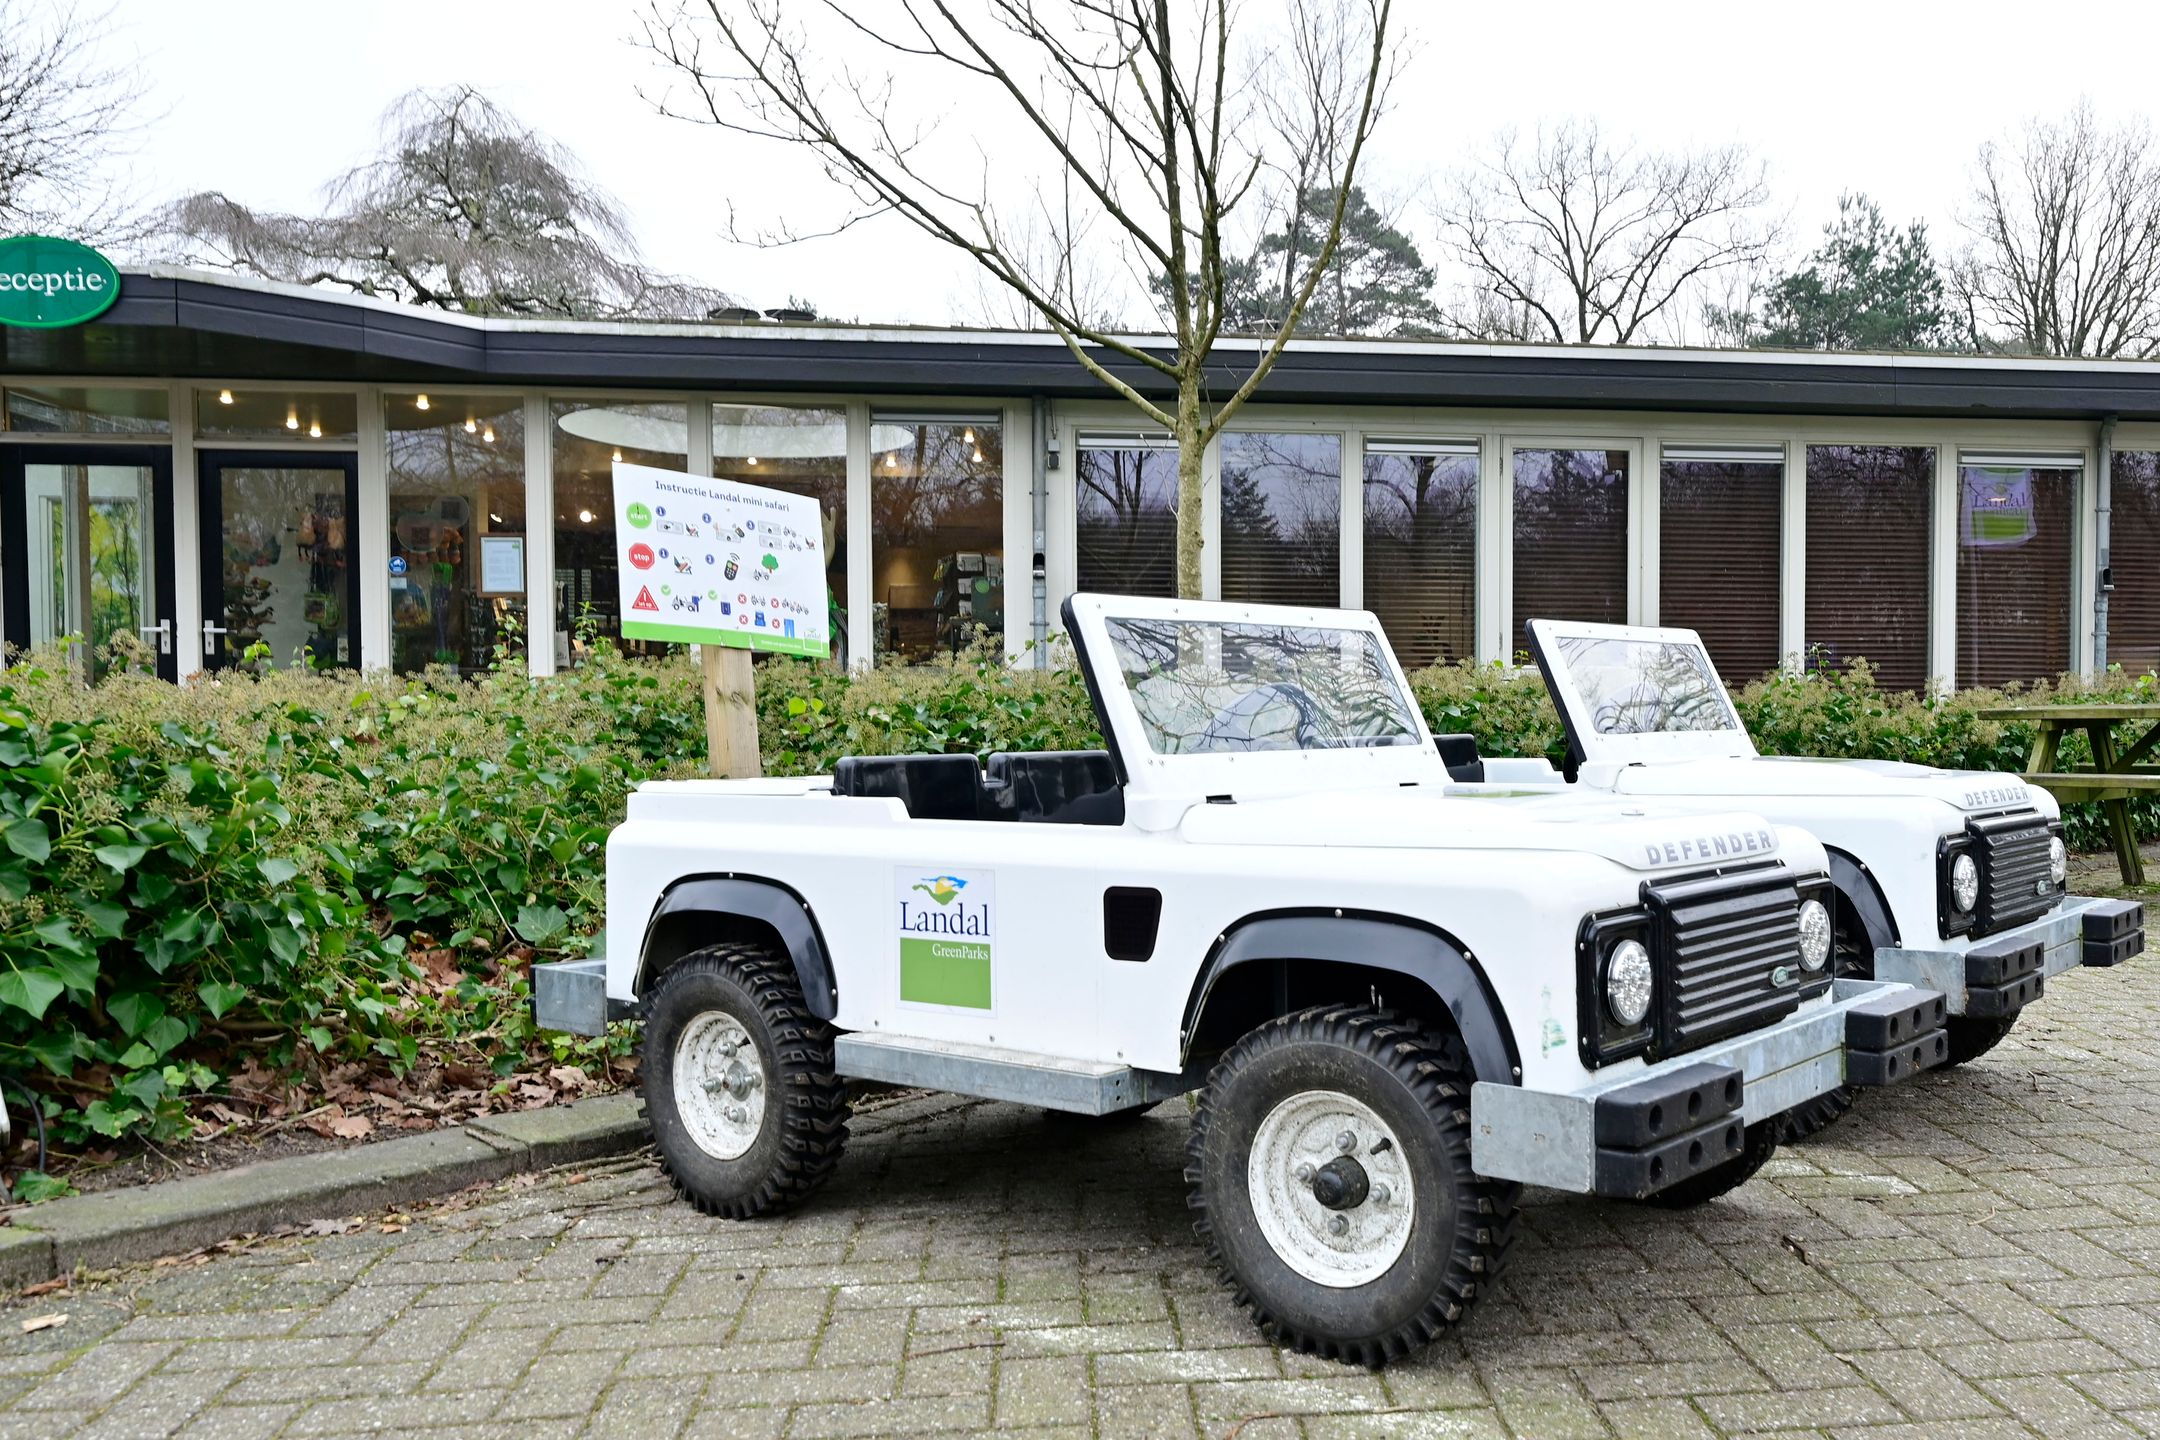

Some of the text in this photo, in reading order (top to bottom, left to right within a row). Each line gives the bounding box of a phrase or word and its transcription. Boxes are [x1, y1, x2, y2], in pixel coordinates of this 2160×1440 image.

[655, 480, 789, 512] Instructie Landal mini safari
[633, 553, 650, 563] stop
[1965, 786, 2029, 807] DEFENDER
[1645, 830, 1771, 865] DEFENDER
[900, 901, 990, 936] Landal
[932, 943, 988, 960] GreenParks
